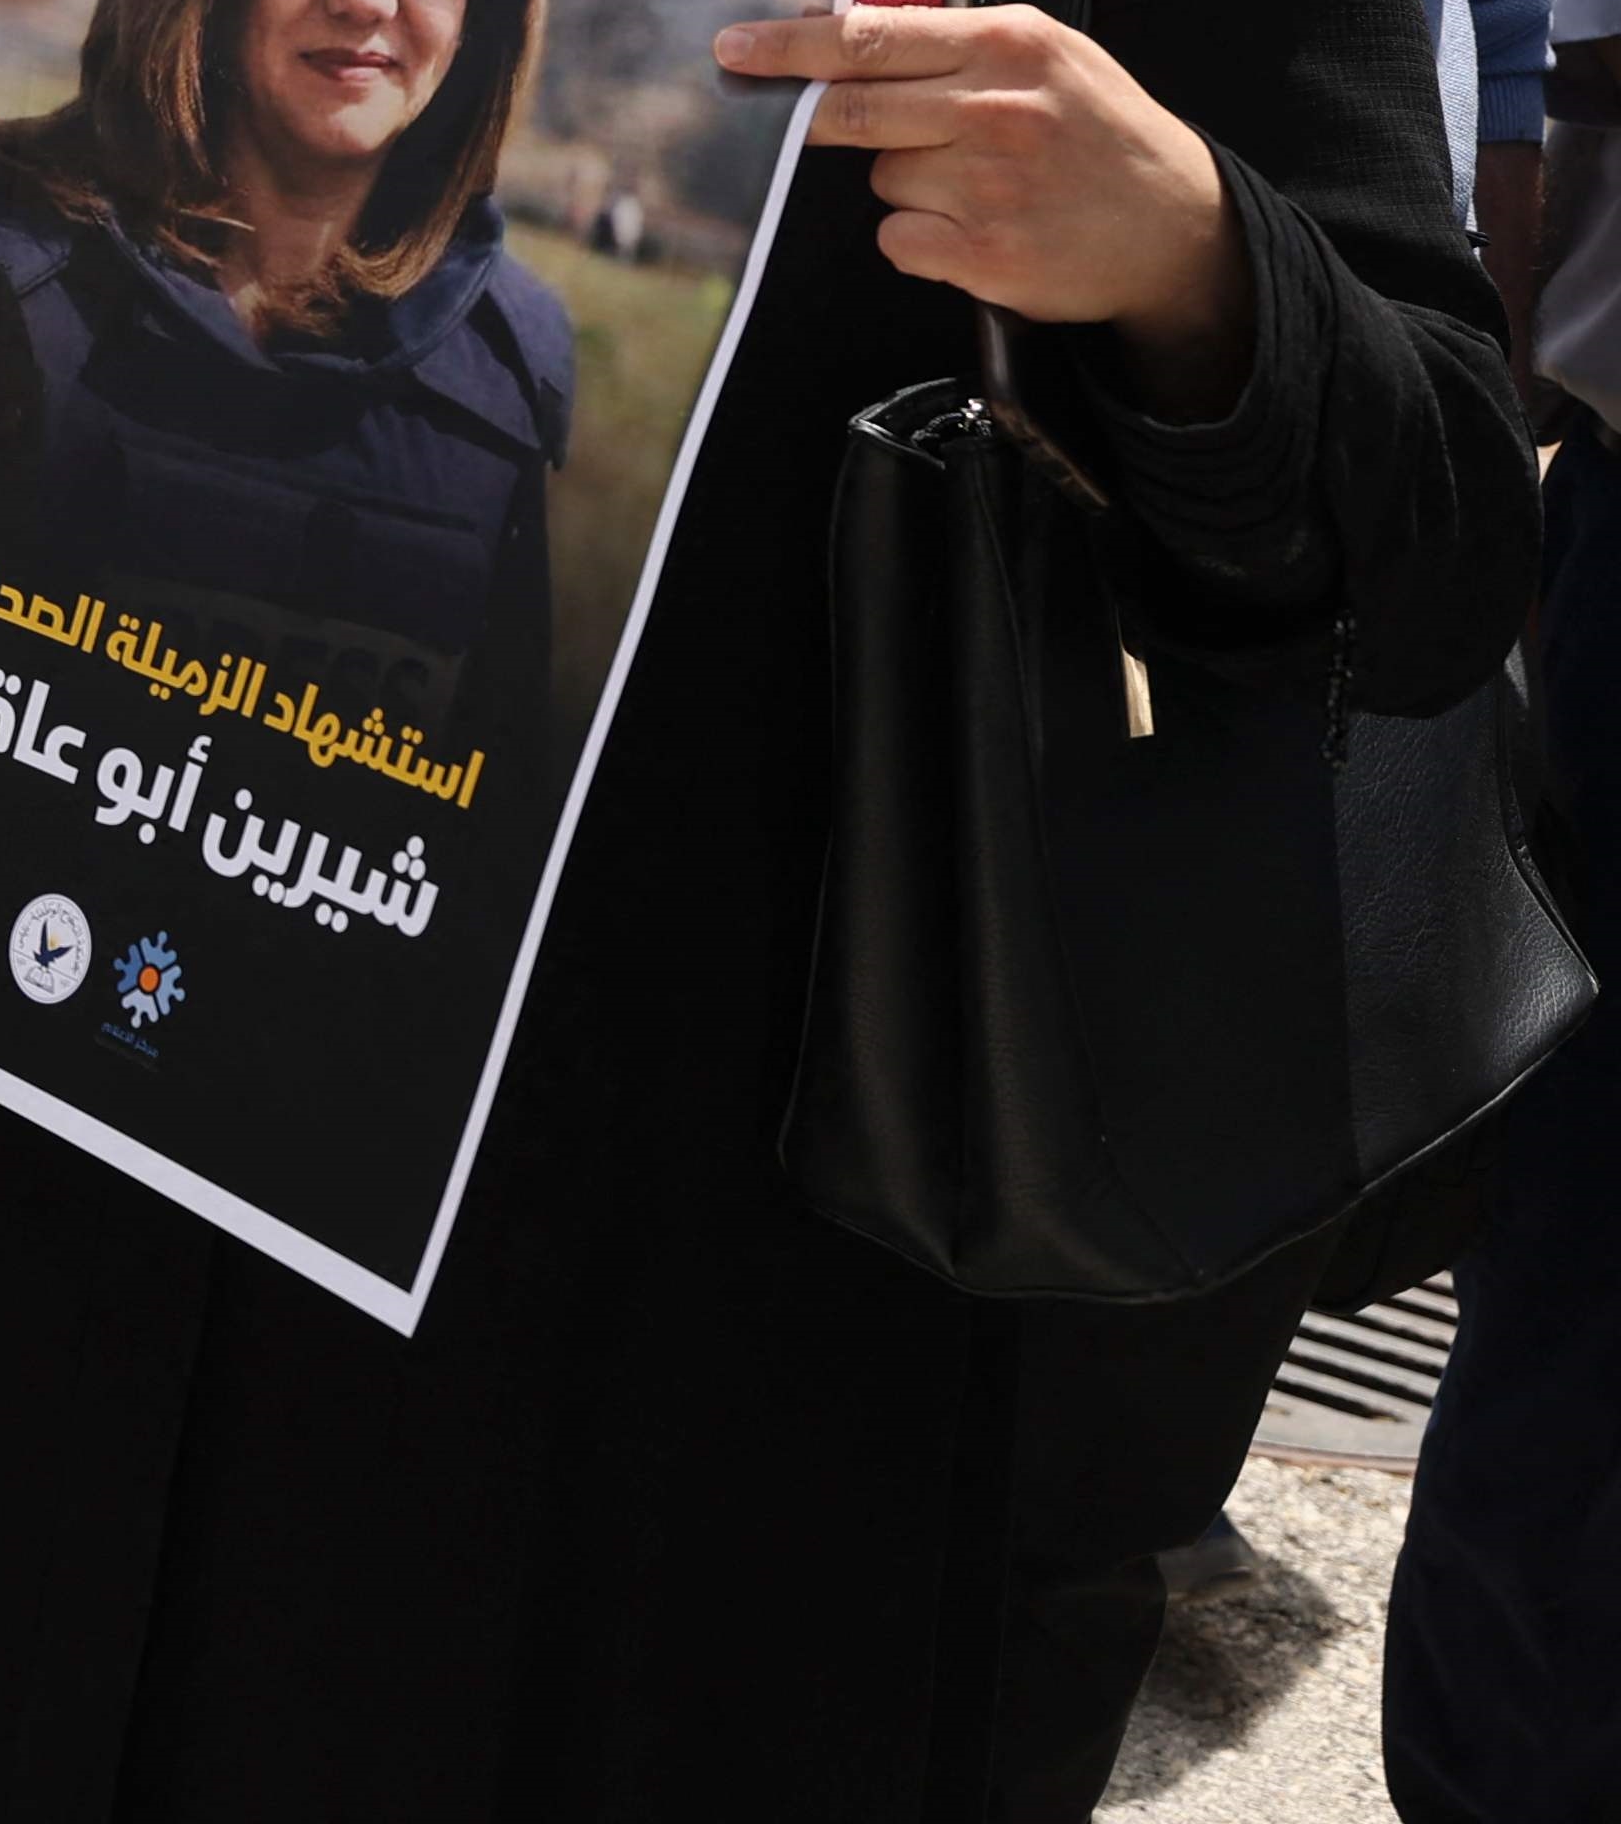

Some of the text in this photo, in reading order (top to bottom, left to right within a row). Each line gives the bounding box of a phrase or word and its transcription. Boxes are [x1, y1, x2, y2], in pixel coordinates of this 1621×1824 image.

[105, 613, 267, 718] الزميلة
[94, 735, 212, 845] أبو
[263, 682, 485, 809] استشهاد
[202, 788, 440, 937] شيرين
